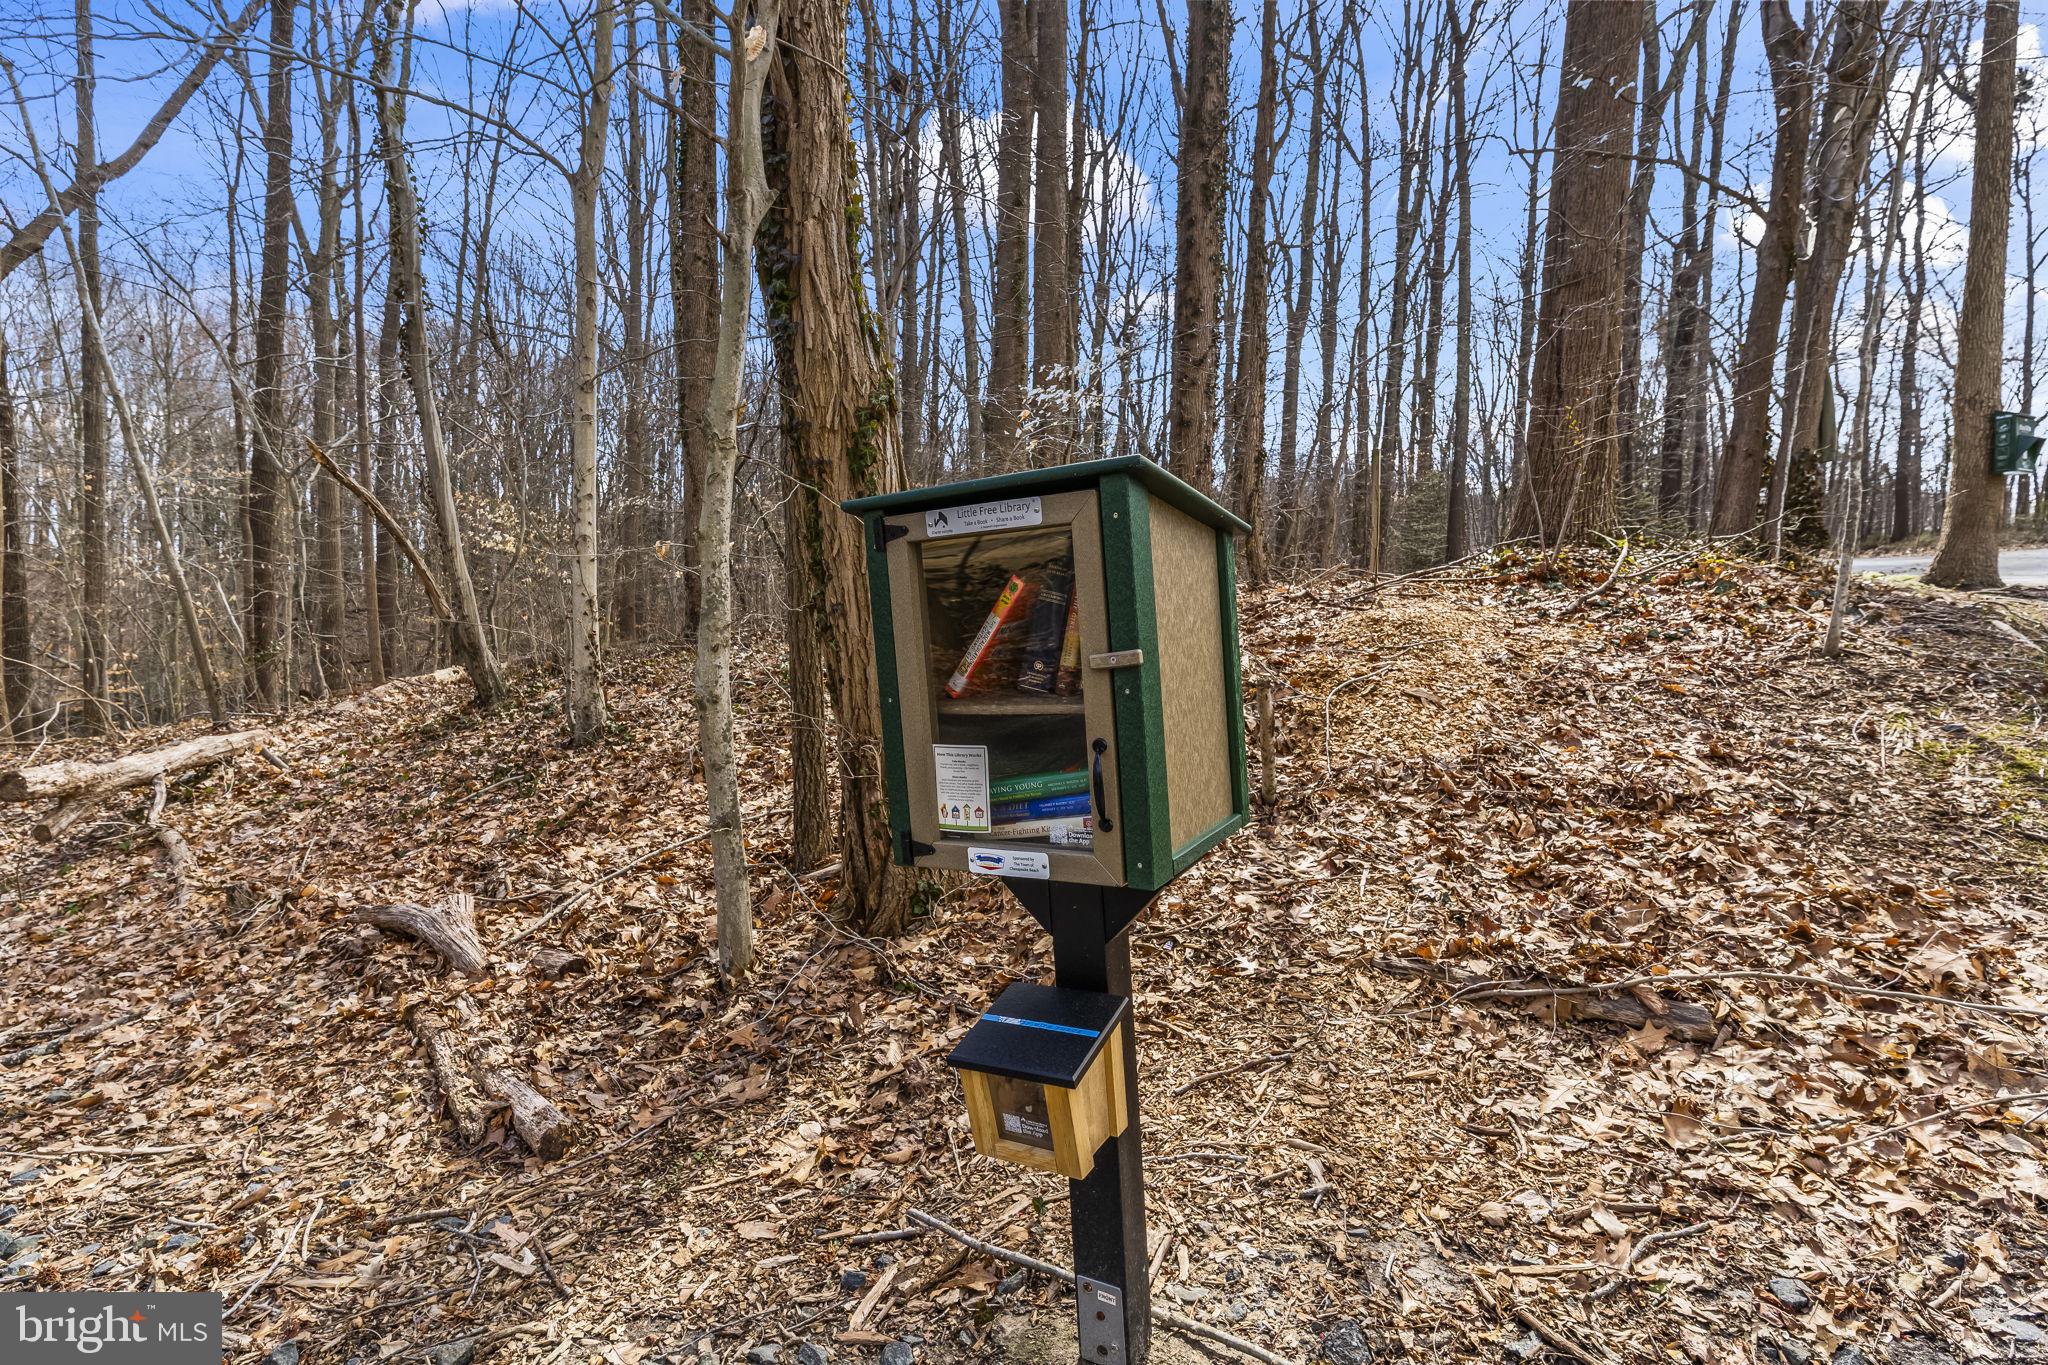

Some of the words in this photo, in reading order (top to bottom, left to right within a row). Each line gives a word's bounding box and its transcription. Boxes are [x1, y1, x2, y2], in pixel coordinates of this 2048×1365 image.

[957, 508, 978, 519] Little
[979, 506, 997, 515] Free
[1000, 502, 1031, 514] Library
[1014, 781, 1043, 791] YOUNG
[1068, 831, 1093, 839] Downloa
[1022, 1123, 1048, 1134] Download
